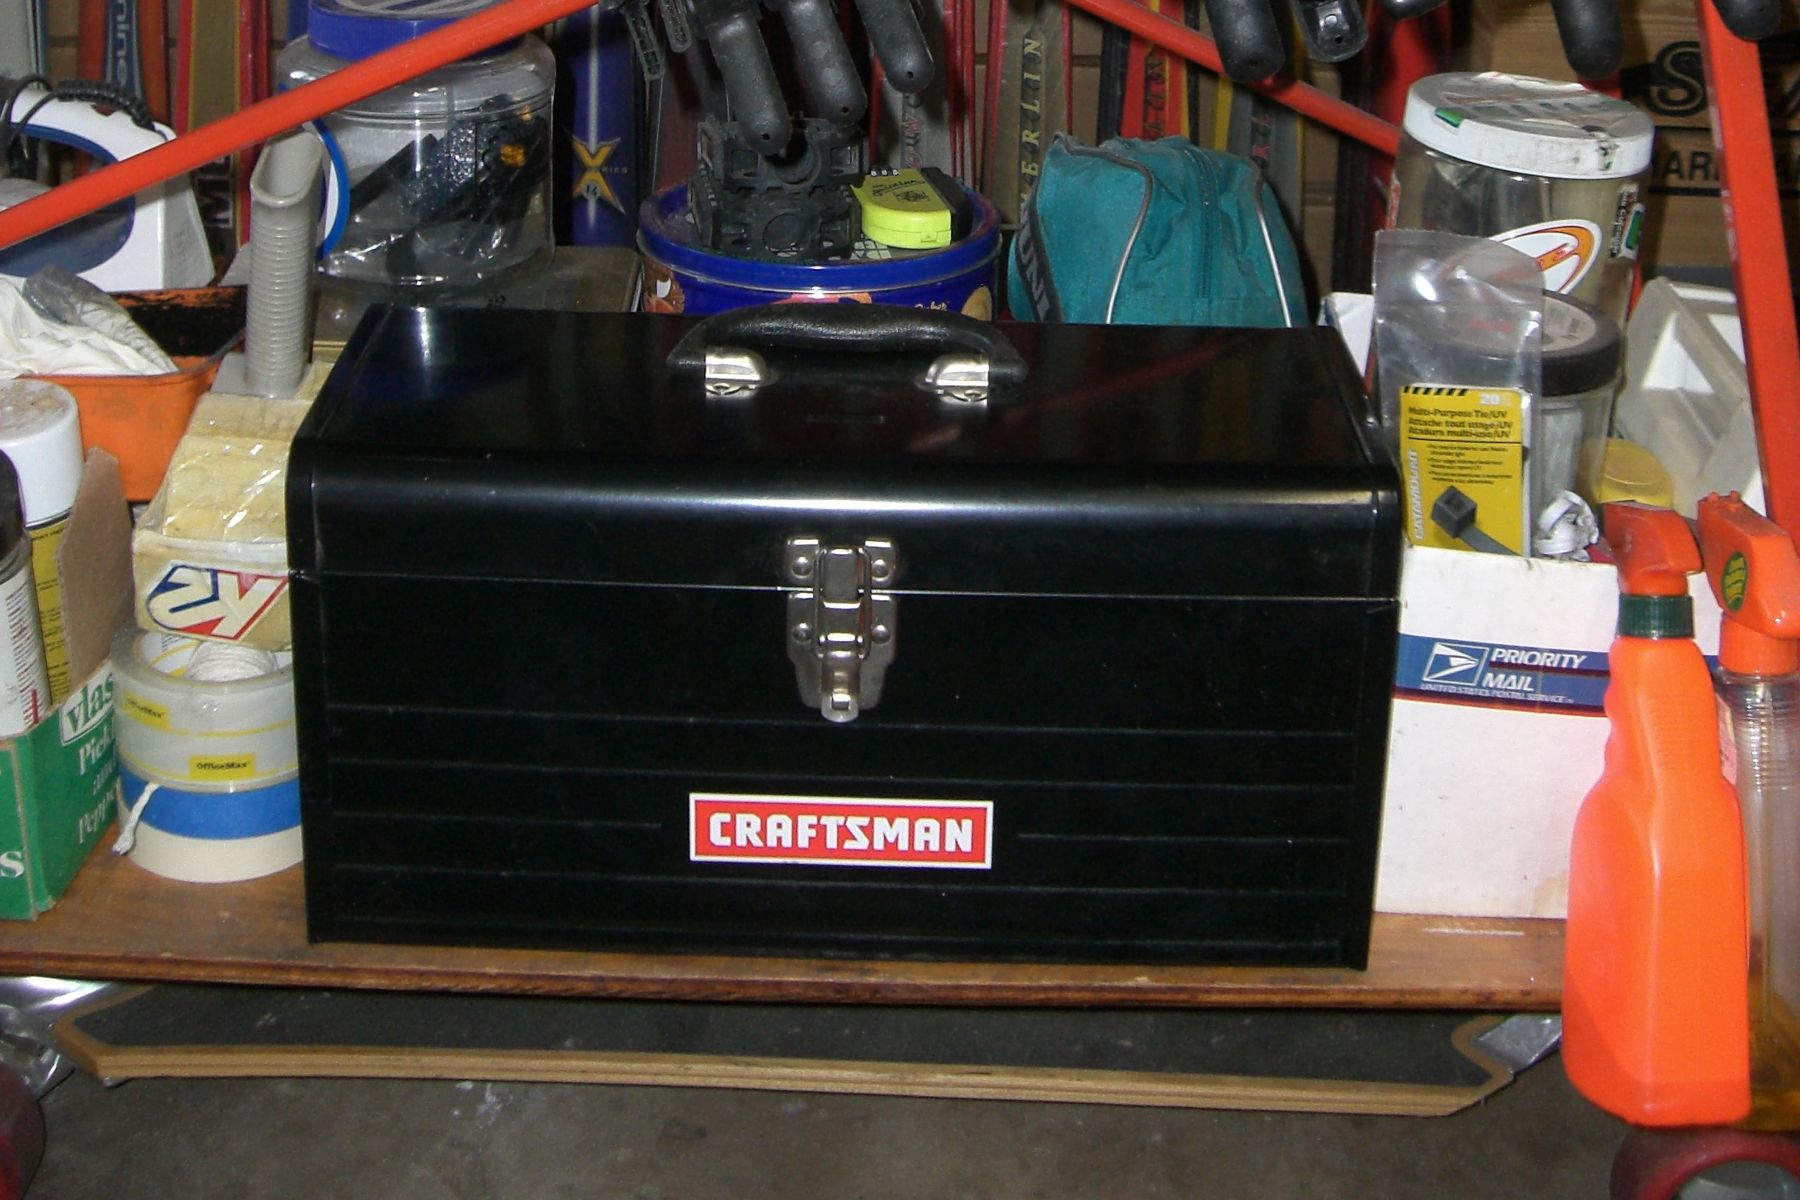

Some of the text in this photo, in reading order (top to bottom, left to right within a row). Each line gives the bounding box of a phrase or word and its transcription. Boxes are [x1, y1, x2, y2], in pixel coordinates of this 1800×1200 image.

[1652, 151, 1719, 182] AR
[1491, 648, 1586, 670] PRIORITY
[1482, 672, 1535, 692] MAIL
[1420, 683, 1566, 704] UNITED STATES POSTAL SERVICE
[196, 761, 248, 771] OfficeMax
[708, 812, 973, 853] CRAFTSMAN
